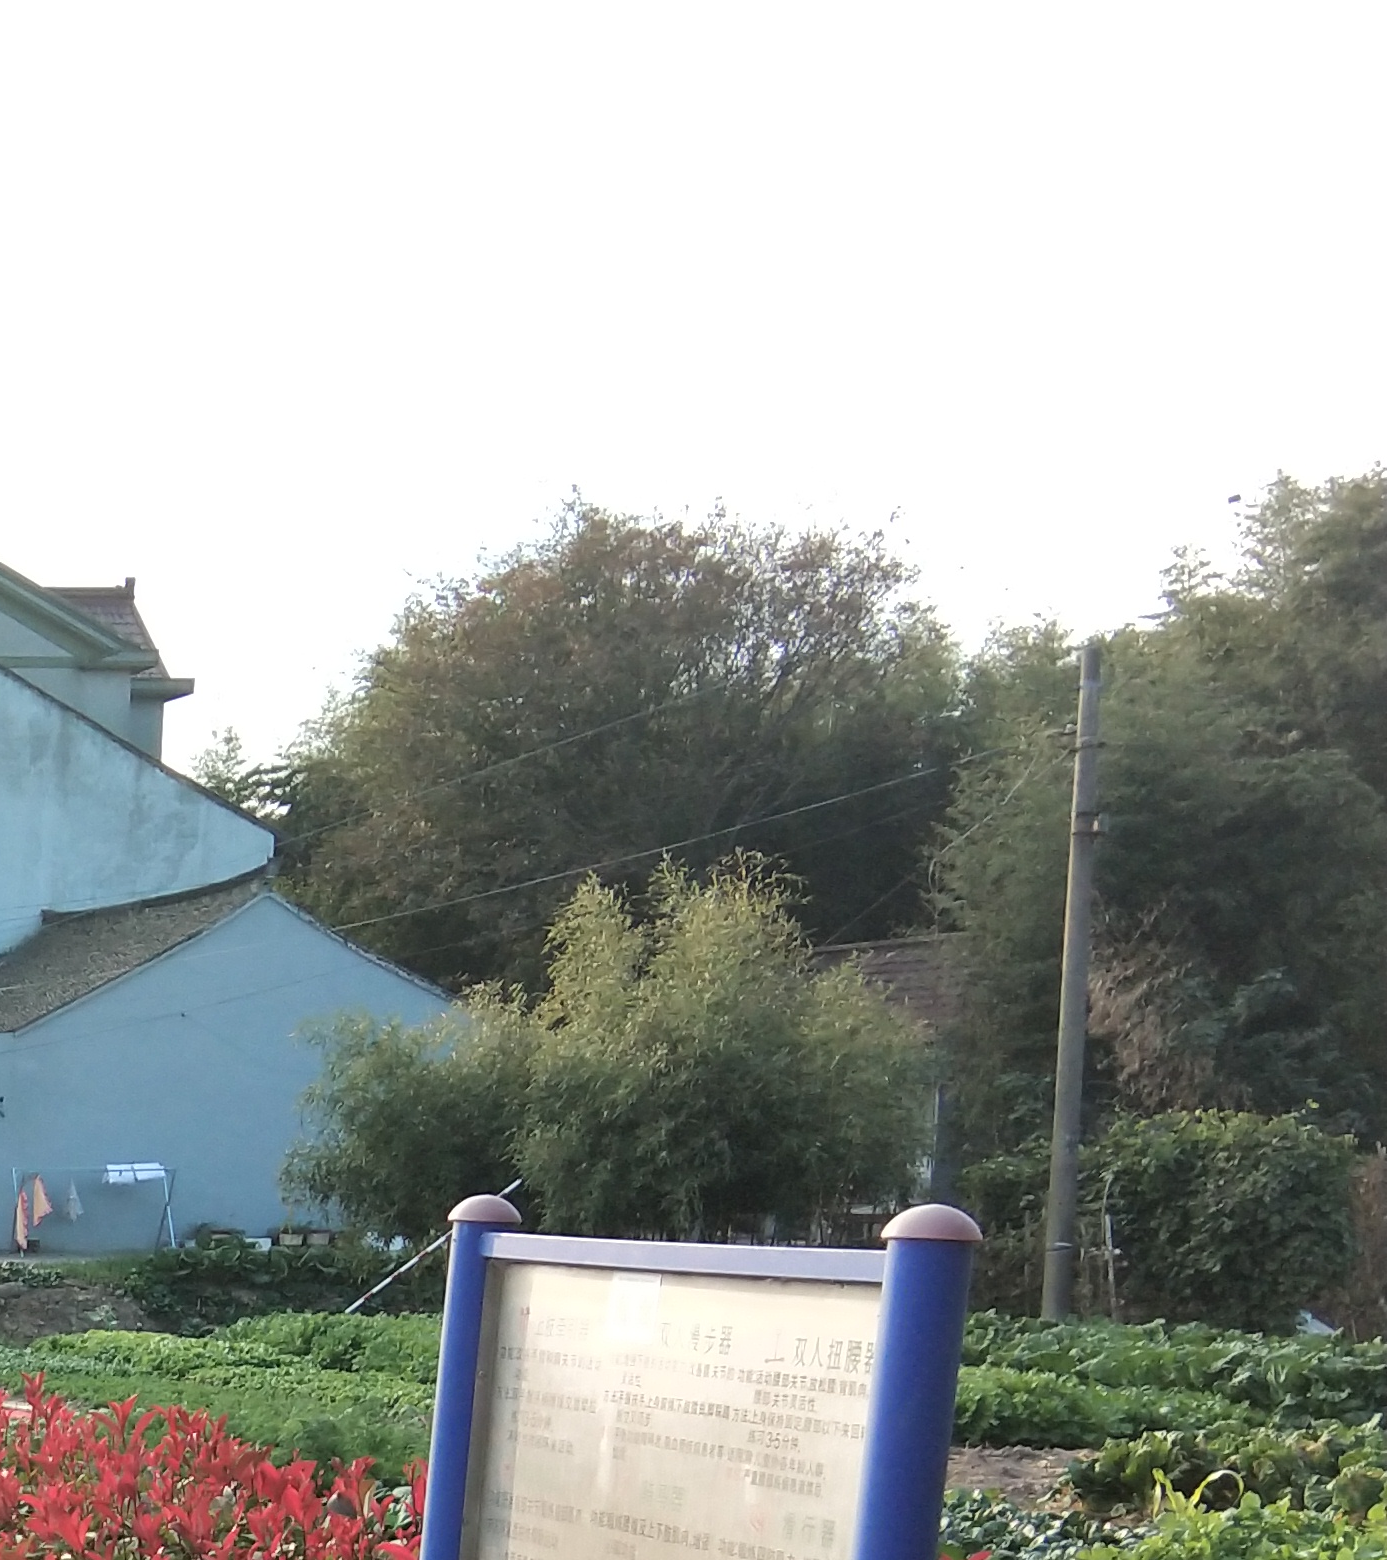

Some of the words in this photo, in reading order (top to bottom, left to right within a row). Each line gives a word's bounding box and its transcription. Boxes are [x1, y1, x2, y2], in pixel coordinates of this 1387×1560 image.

[792, 1334, 875, 1376] 双人扭腰器
